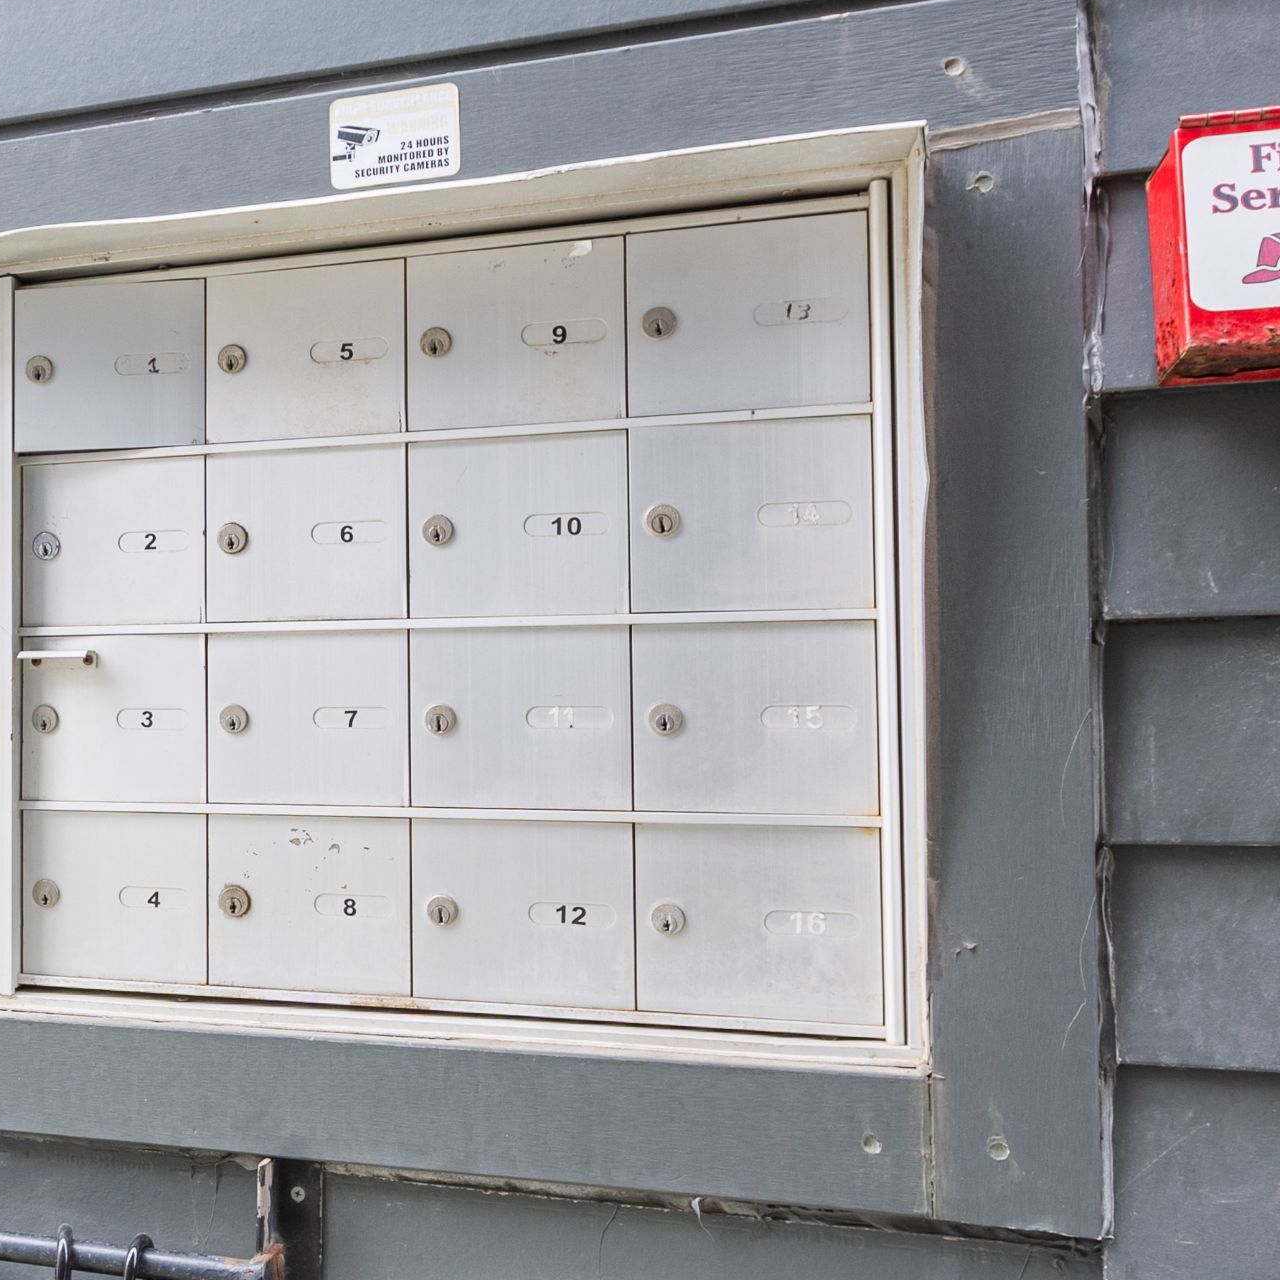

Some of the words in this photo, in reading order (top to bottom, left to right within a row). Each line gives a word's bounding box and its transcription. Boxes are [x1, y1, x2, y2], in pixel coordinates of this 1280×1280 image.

[400, 140, 413, 150] 24
[416, 135, 450, 148] HOURS
[378, 148, 434, 164] MONITORED
[437, 147, 449, 157] BY
[355, 165, 400, 179] SECURITY
[403, 158, 450, 172] CAMERAS
[552, 325, 567, 345] 9
[340, 342, 354, 361] 5
[148, 357, 160, 374] 1
[340, 525, 354, 543] 6
[551, 517, 582, 536] 10
[144, 533, 157, 550] 2
[140, 710, 153, 728] 3
[344, 710, 358, 728] 7
[147, 891, 161, 908] 4
[343, 898, 357, 917] 8
[556, 905, 587, 926] 12
[789, 911, 826, 935] 16
